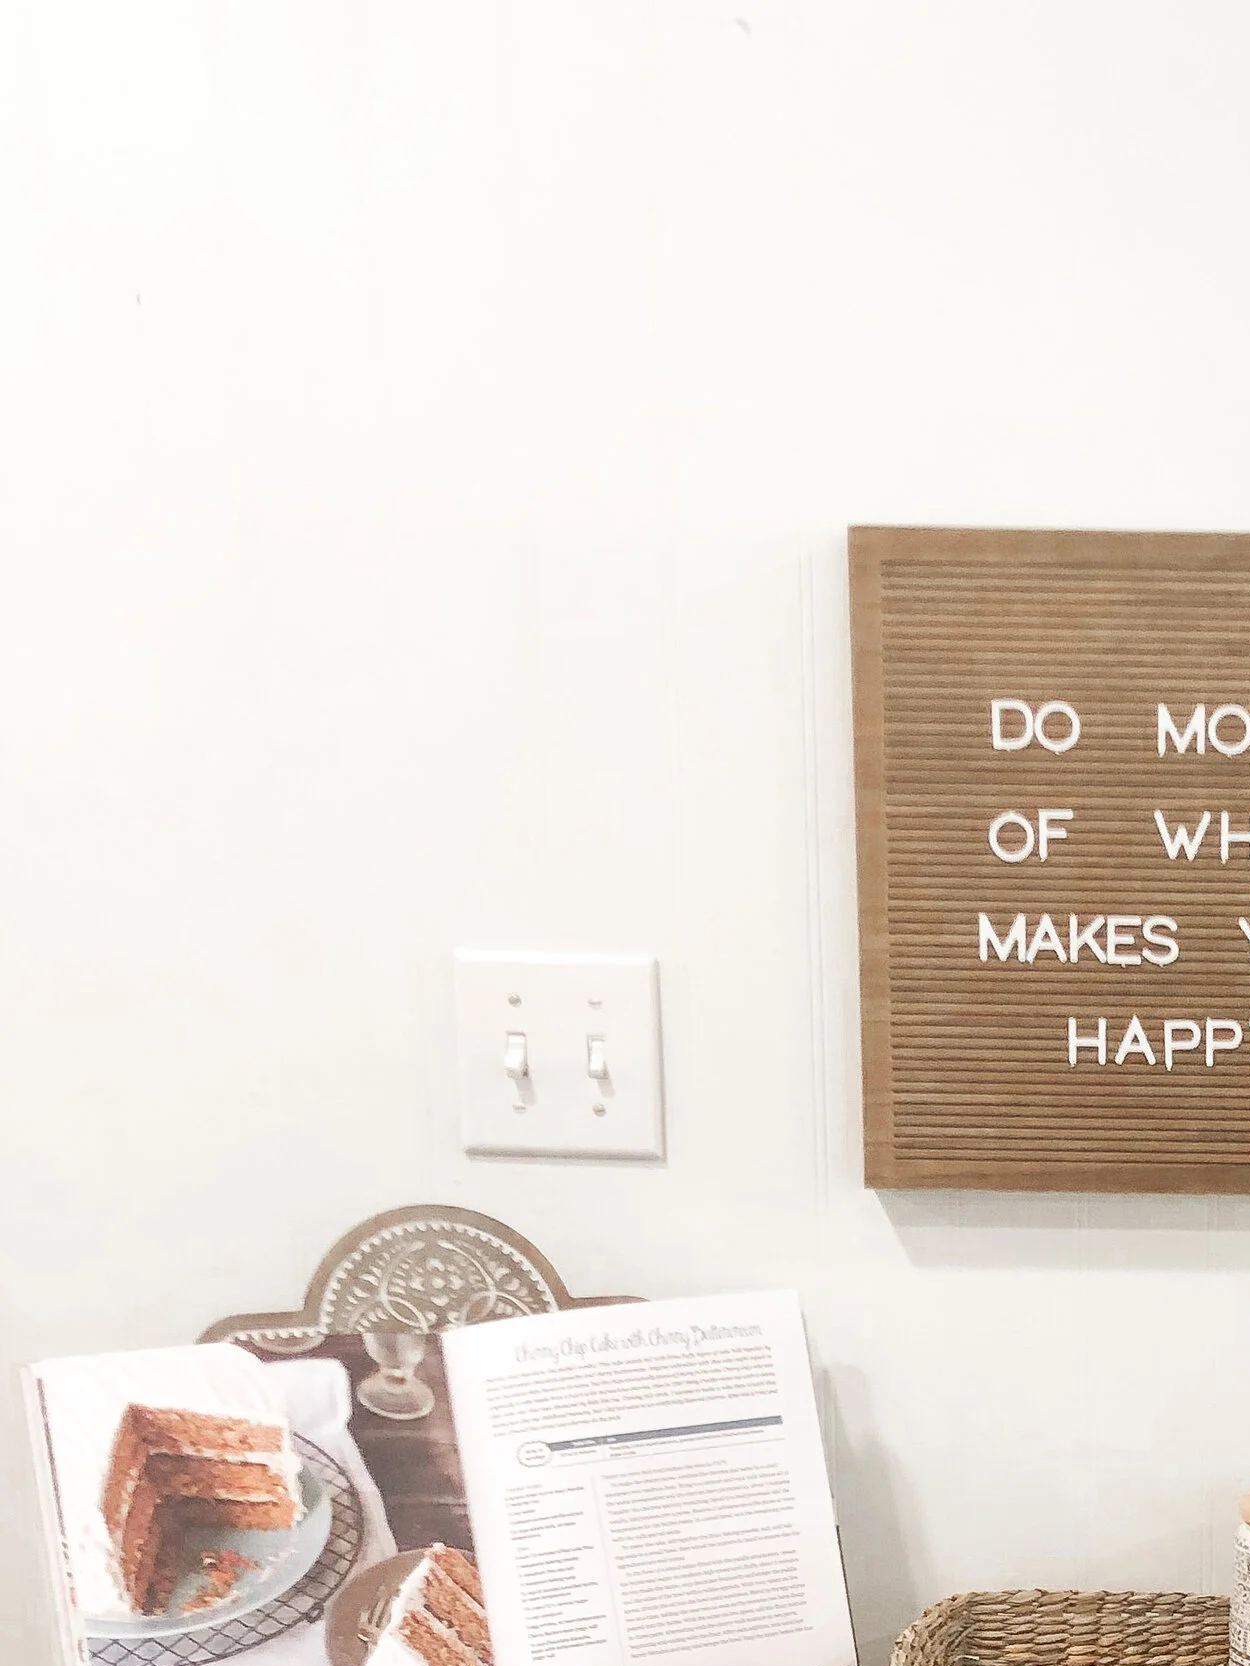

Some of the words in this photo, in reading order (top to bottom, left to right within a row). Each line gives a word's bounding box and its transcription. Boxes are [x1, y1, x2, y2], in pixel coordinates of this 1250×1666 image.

[990, 699, 1081, 756] DO
[988, 808, 1074, 863] OF
[978, 912, 1179, 967] MAKES
